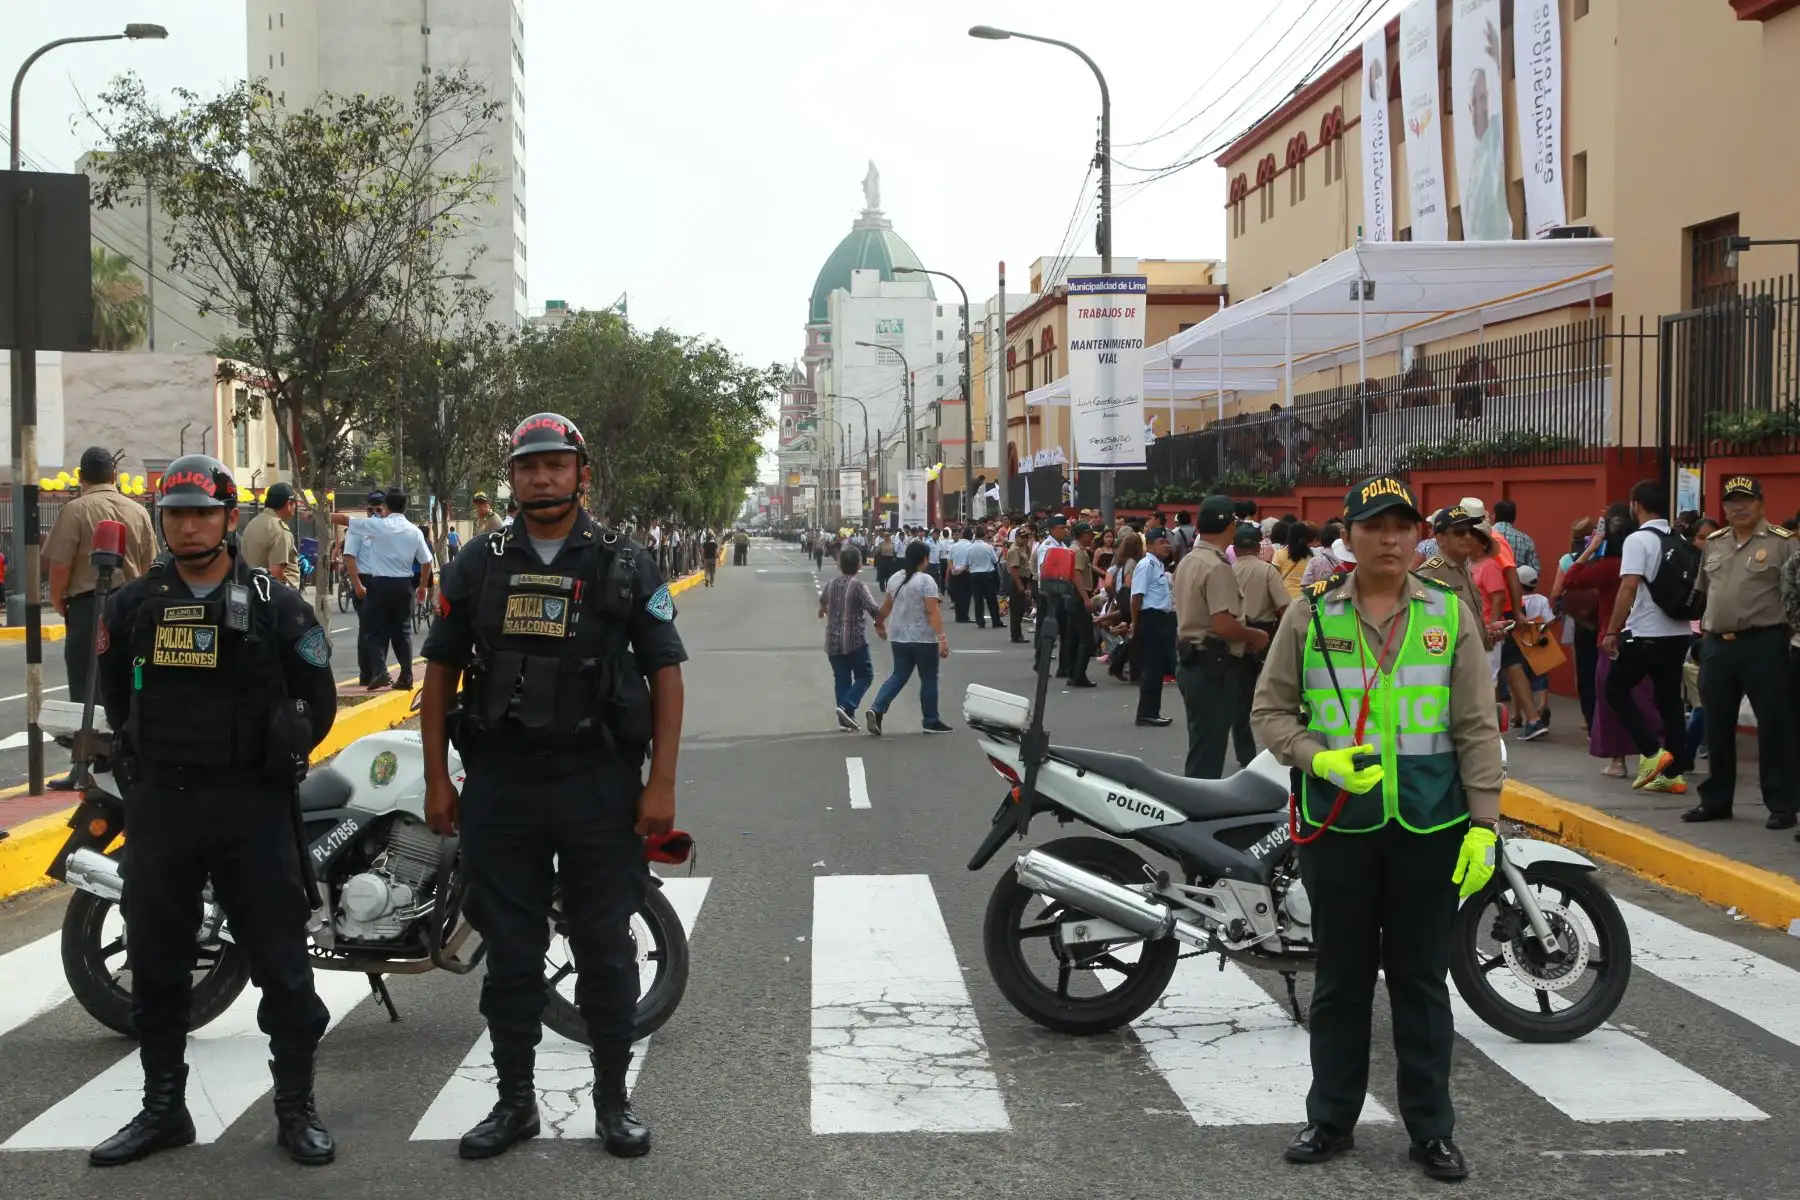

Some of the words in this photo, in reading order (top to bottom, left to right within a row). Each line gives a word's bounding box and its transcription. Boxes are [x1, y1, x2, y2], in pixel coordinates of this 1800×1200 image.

[1542, 3, 1553, 100] Toribio
[1530, 43, 1544, 174] Seminario
[1542, 106, 1554, 184] Santo
[1067, 281, 1117, 292] Municipalidad
[1118, 281, 1127, 290] de
[1128, 281, 1146, 290] Lima
[1078, 308, 1122, 319] TRABAJOS
[1125, 307, 1136, 318] DE
[1070, 338, 1143, 351] MANTENIMIENTO
[1098, 353, 1117, 364] VIAL
[1361, 477, 1412, 507] POLICIA
[1725, 477, 1753, 493] POLICIA
[508, 598, 543, 618] POLICIA
[505, 620, 562, 634] HALCONES
[157, 626, 193, 649] POLICIA
[156, 650, 214, 665] HALCONES
[1106, 791, 1165, 822] POLICIA
[312, 818, 359, 862] PL-17856
